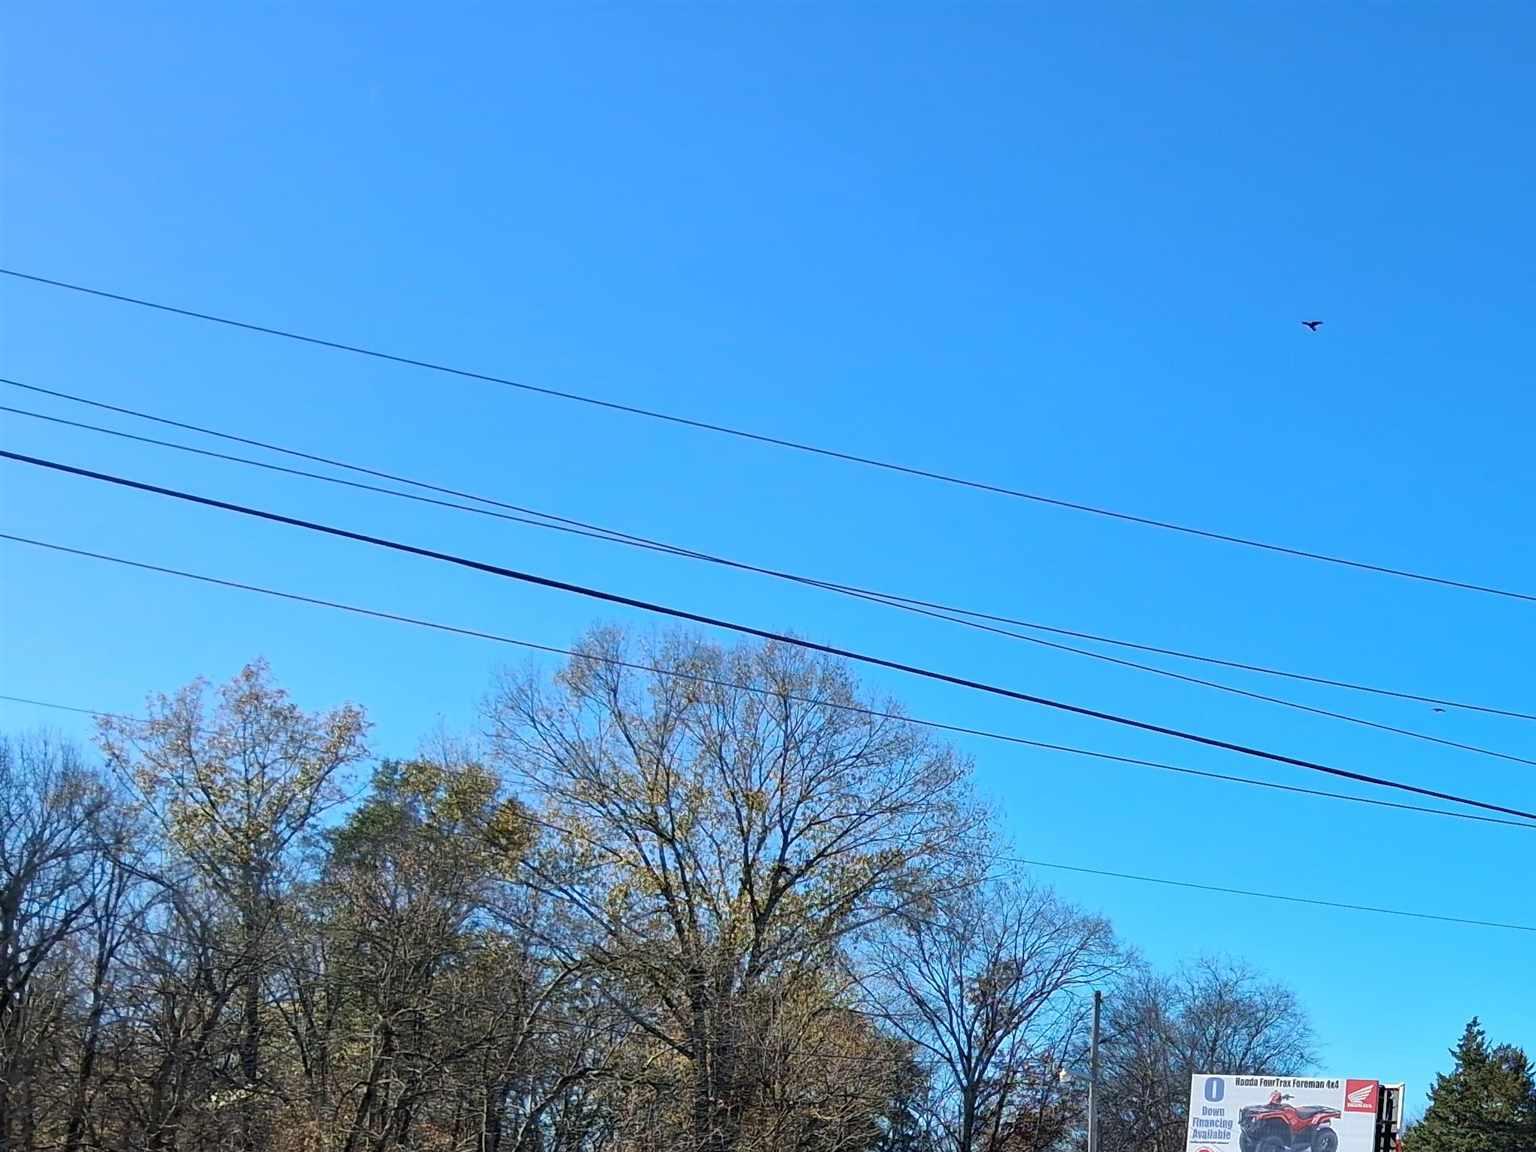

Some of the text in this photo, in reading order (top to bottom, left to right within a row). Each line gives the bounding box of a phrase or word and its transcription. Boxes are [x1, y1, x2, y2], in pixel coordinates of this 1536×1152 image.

[1235, 1077, 1258, 1087] Honda
[1259, 1078, 1291, 1088] FourTrax
[1292, 1079, 1325, 1089] Foreman
[1204, 1077, 1225, 1102] 0
[1202, 1106, 1225, 1116] Down
[1192, 1117, 1233, 1129] Financing
[1192, 1128, 1231, 1139] Available
